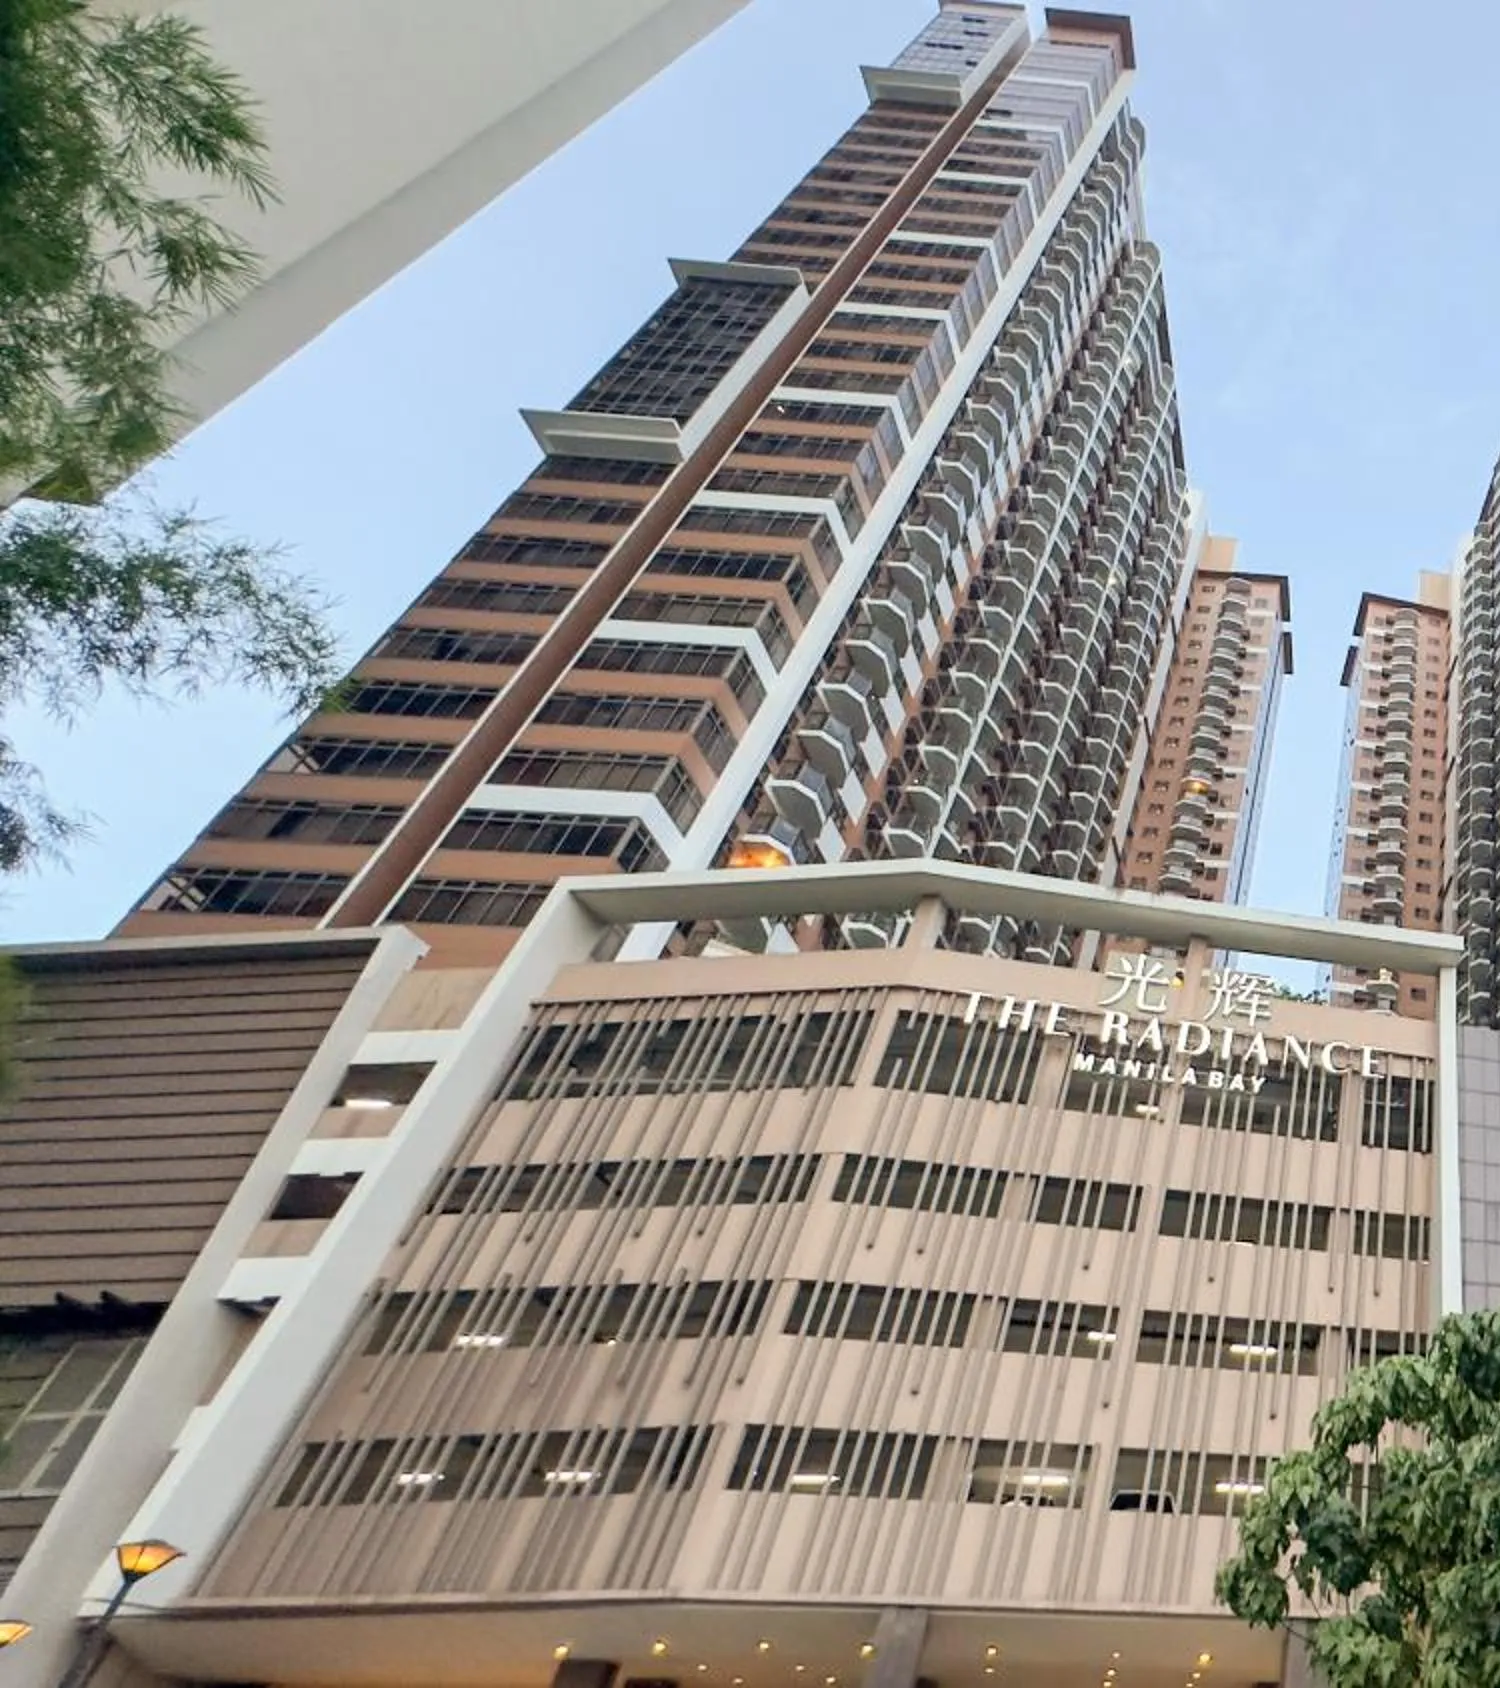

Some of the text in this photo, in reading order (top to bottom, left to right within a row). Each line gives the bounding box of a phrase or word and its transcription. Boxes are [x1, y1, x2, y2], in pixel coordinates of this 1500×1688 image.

[1098, 954, 1276, 1027] 光辉
[963, 991, 1388, 1078] THE RADIANCE
[1074, 1053, 1267, 1094] MANILA BAY
